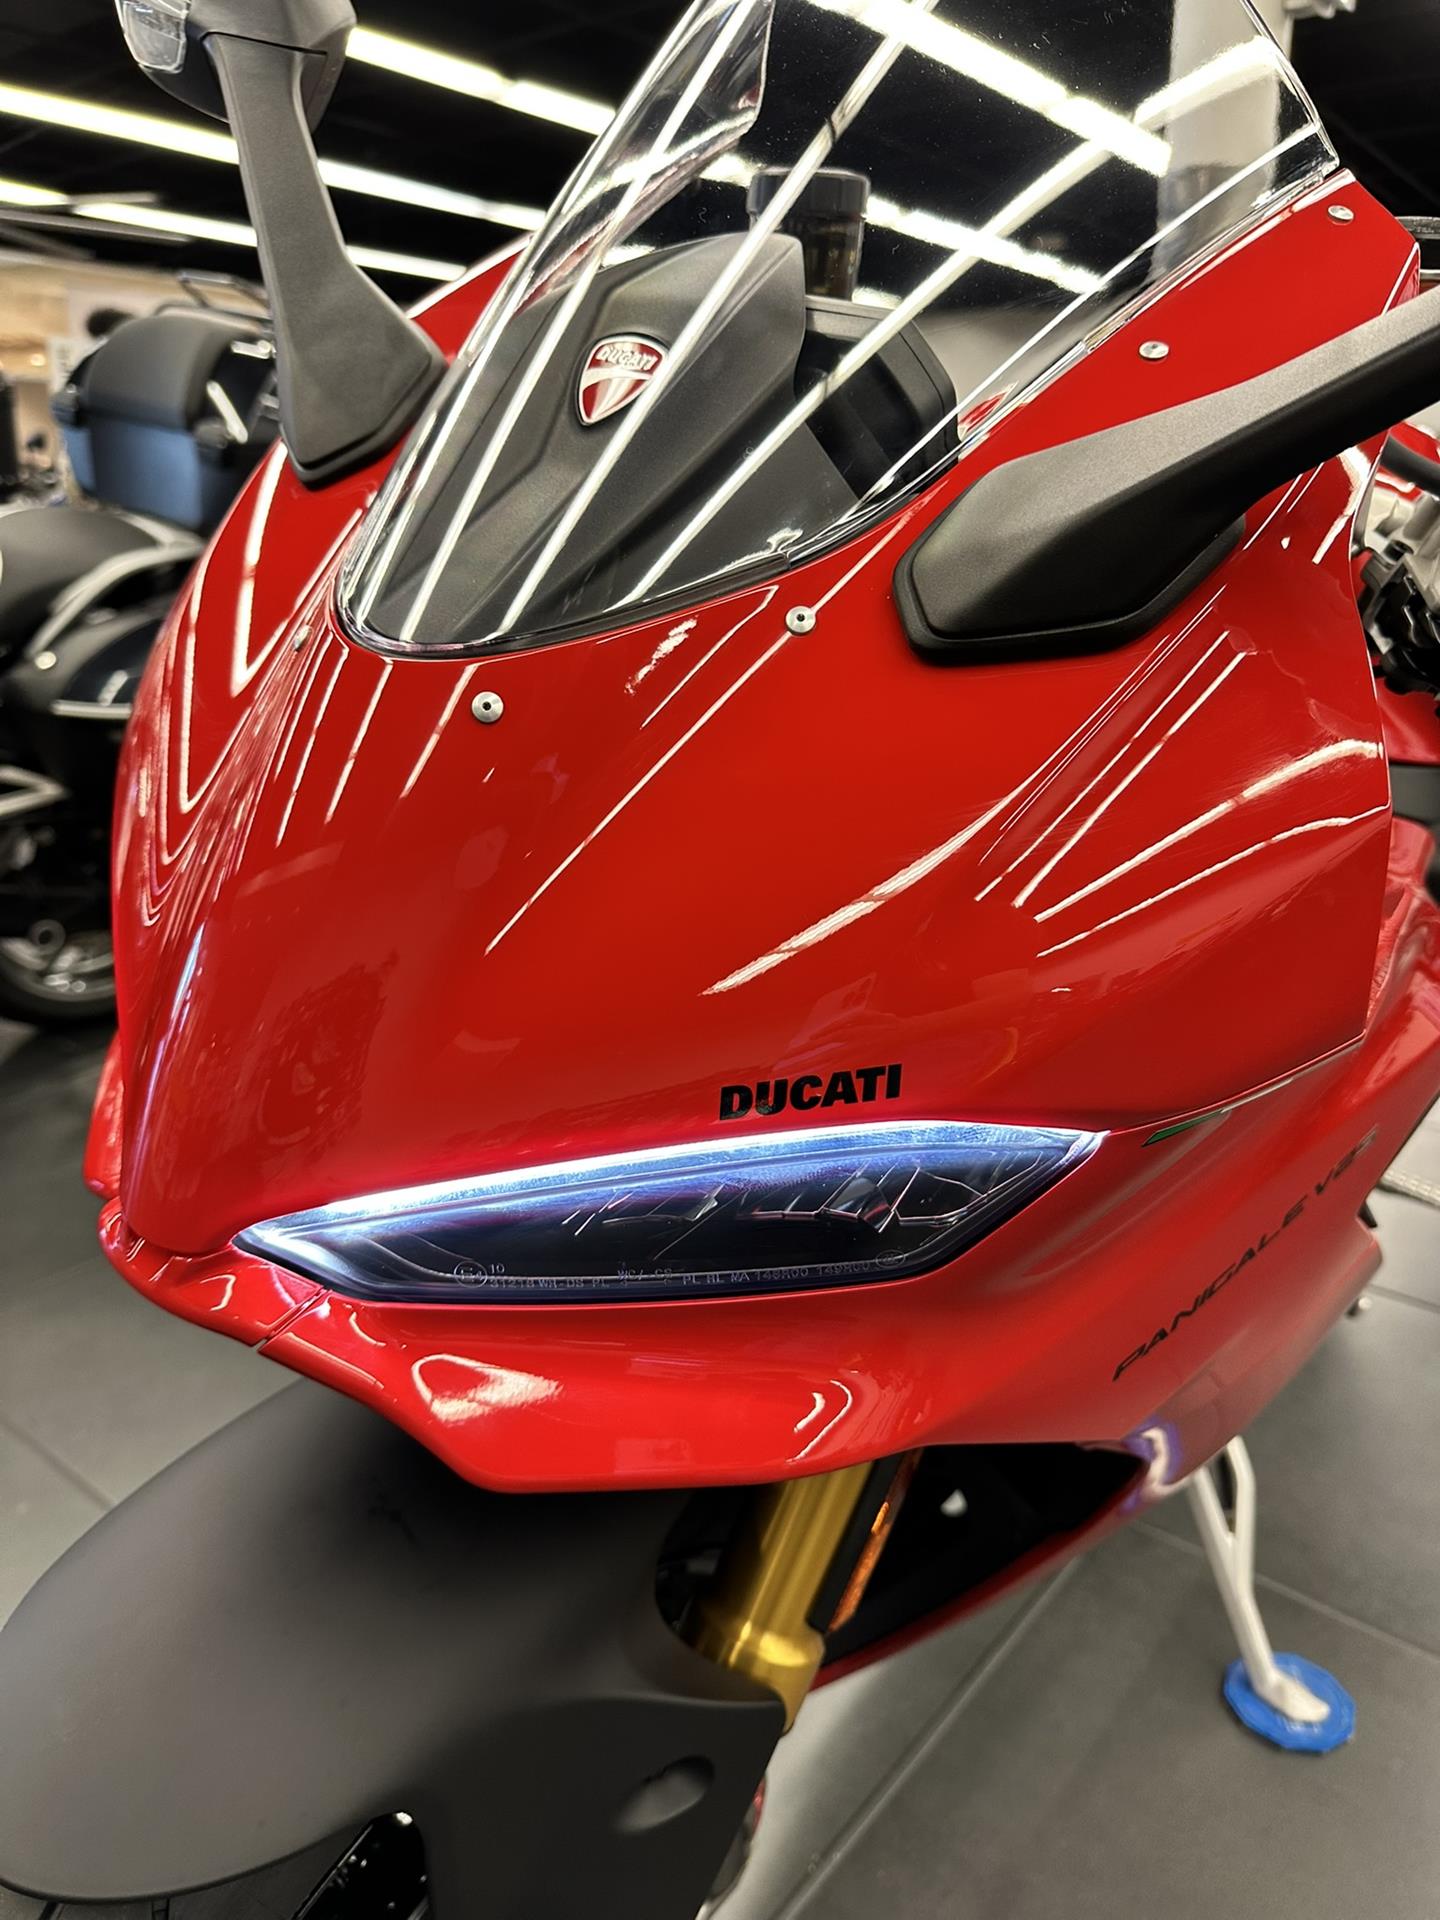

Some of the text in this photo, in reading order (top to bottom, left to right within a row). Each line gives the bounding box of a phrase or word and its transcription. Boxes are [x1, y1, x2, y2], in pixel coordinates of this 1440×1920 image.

[595, 345, 659, 371] DUCATI
[719, 1063, 902, 1121] DUCATI
[1112, 1194, 1309, 1382] PANIGALE
